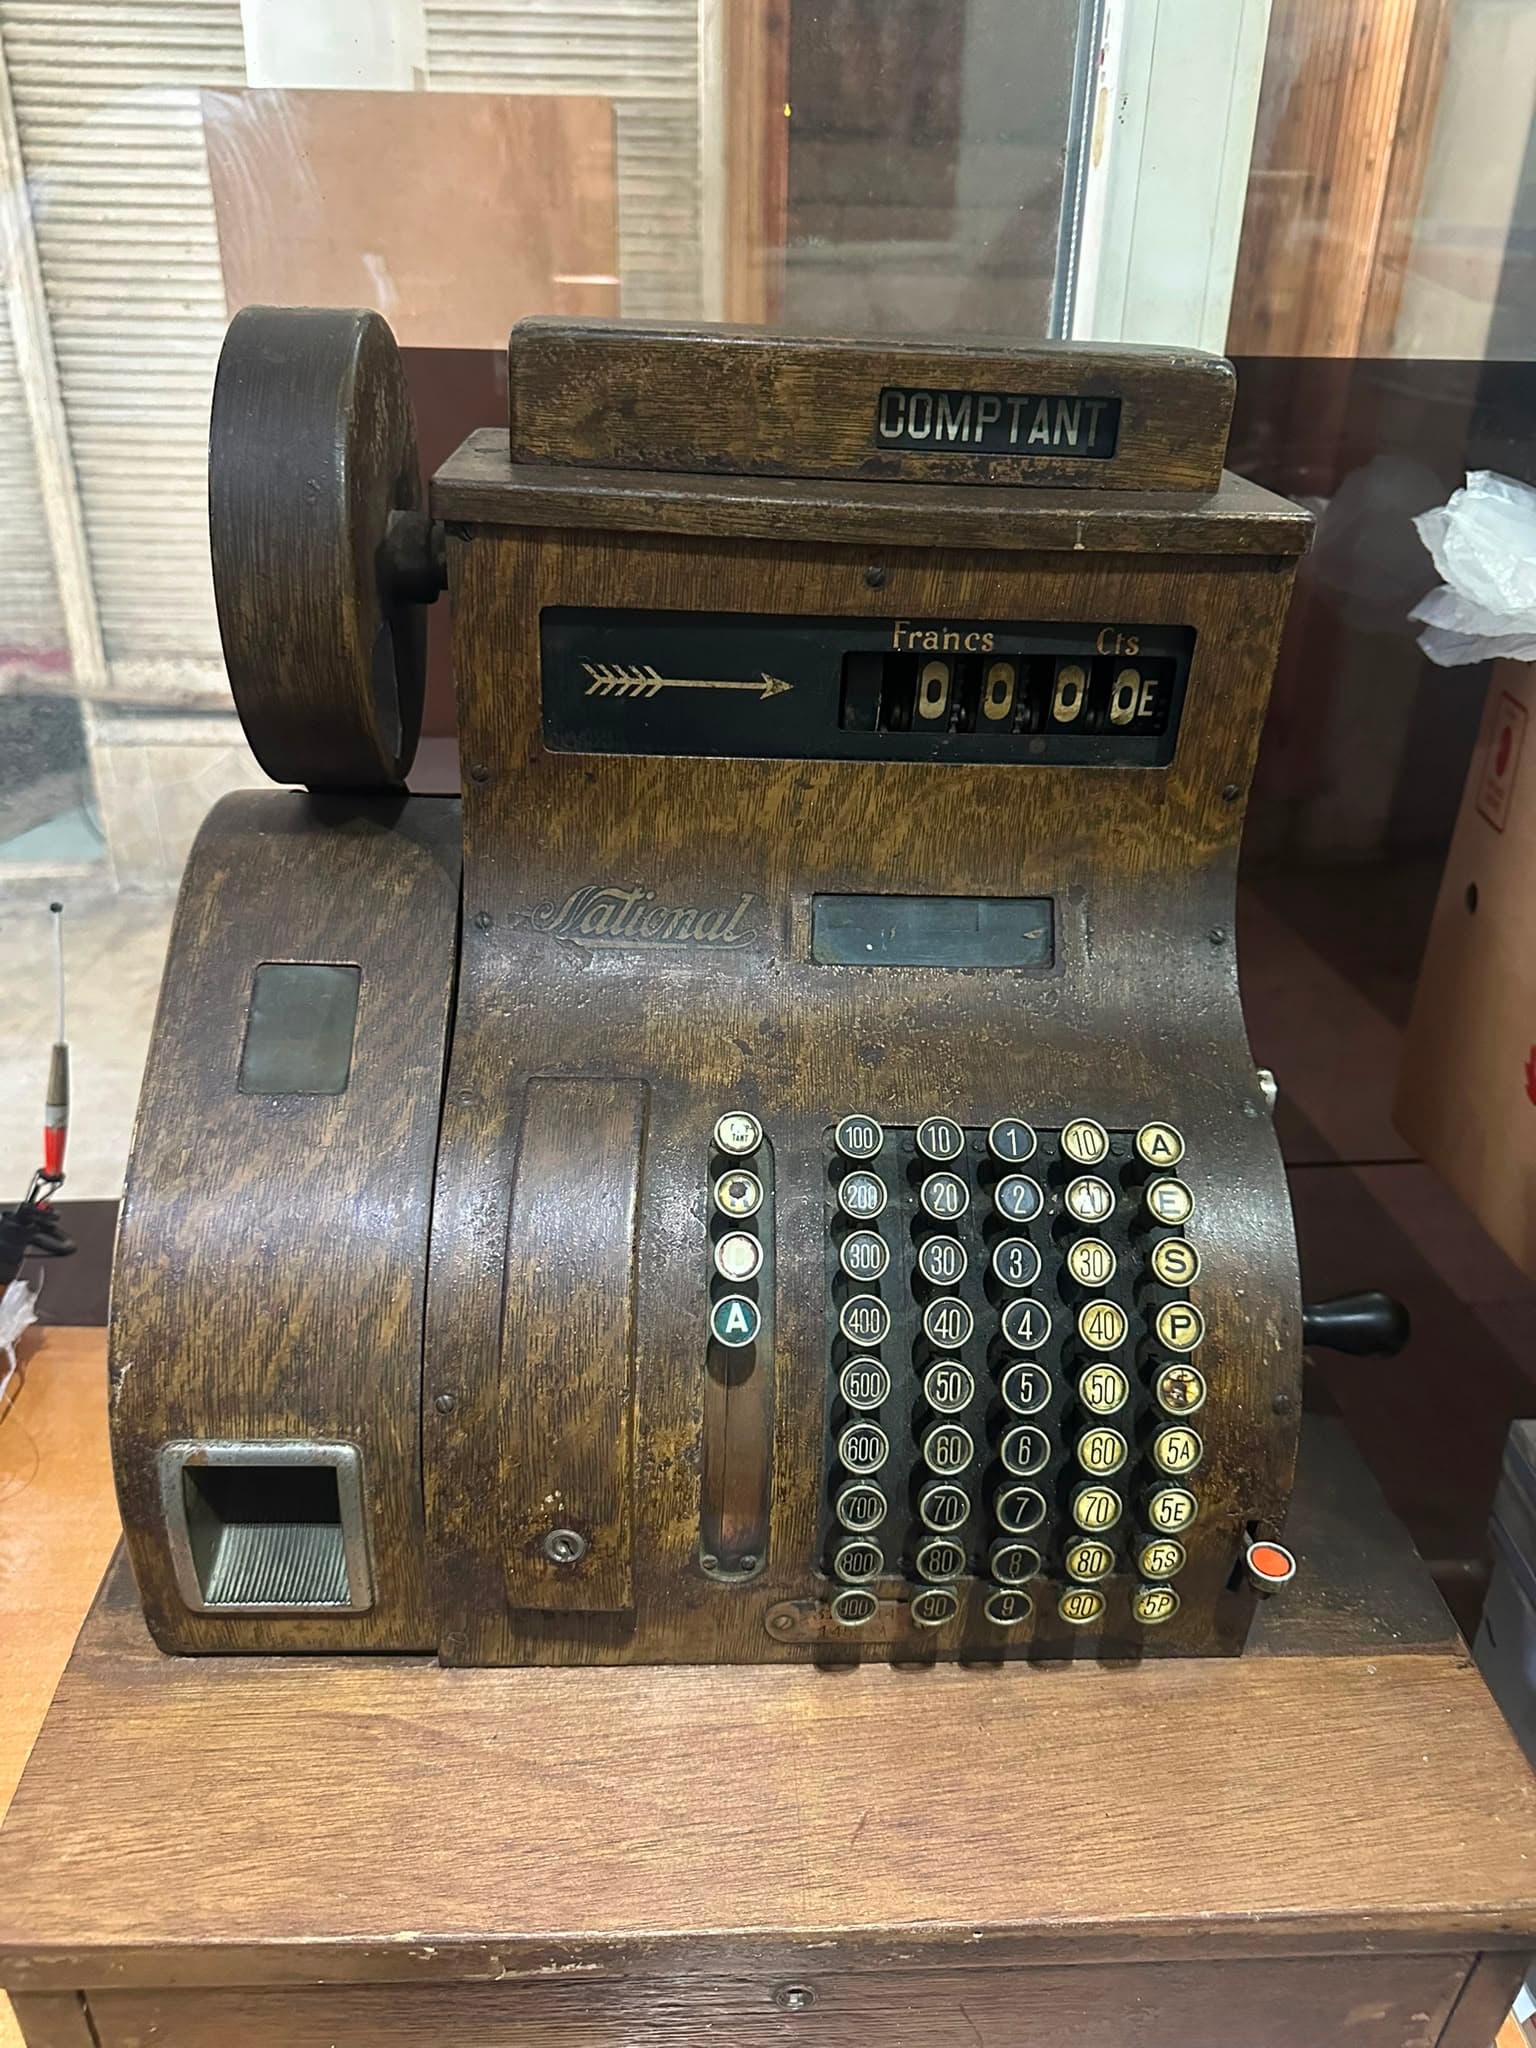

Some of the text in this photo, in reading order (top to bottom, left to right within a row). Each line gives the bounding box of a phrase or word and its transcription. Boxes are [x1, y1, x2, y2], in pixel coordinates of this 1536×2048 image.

[879, 391, 1108, 447] COMPTANT
[892, 620, 1140, 656] Francs Cts
[919, 661, 949, 720] 0
[984, 662, 1016, 721] 0
[1053, 665, 1087, 723] 0
[531, 886, 757, 949] National
[846, 1127, 872, 1148] 100
[929, 1127, 950, 1153] 10
[1010, 1131, 1017, 1155] 1
[1073, 1130, 1096, 1156] 10
[1151, 1135, 1171, 1155] A
[848, 1185, 876, 1208] 200
[933, 1184, 957, 1212] 20
[1013, 1187, 1025, 1213] 2
[1159, 1192, 1181, 1214] E
[851, 1245, 879, 1268] 300
[931, 1248, 954, 1276] 30
[1010, 1249, 1022, 1276] 3
[1080, 1249, 1103, 1277] 30
[1165, 1251, 1186, 1273] S
[724, 1303, 748, 1333] A
[849, 1308, 880, 1333] 400
[934, 1309, 960, 1338] 40
[1018, 1310, 1032, 1340] 4
[1090, 1312, 1115, 1340] 40
[1170, 1316, 1191, 1339] P
[850, 1372, 880, 1397] 500
[937, 1372, 961, 1401] 50
[1021, 1373, 1033, 1402] 5
[1091, 1374, 1115, 1403] 50
[847, 1437, 879, 1461] 600
[936, 1437, 961, 1464] 60
[1018, 1436, 1031, 1464] 6
[1091, 1437, 1114, 1465] 60
[1167, 1438, 1190, 1464] 5A
[846, 1497, 878, 1519] 700
[933, 1495, 959, 1523] 70
[1014, 1497, 1030, 1523] 7
[1086, 1496, 1109, 1523] 70
[1161, 1495, 1185, 1522] 5E
[843, 1551, 874, 1573] 800
[929, 1550, 953, 1573] 80
[1009, 1551, 1022, 1575] 8
[1078, 1550, 1103, 1574] 80
[1151, 1550, 1175, 1573] 5S
[924, 1595, 947, 1617] 90
[1002, 1596, 1014, 1616] 9
[1066, 1596, 1095, 1616] 90
[1144, 1594, 1170, 1615] 5P
